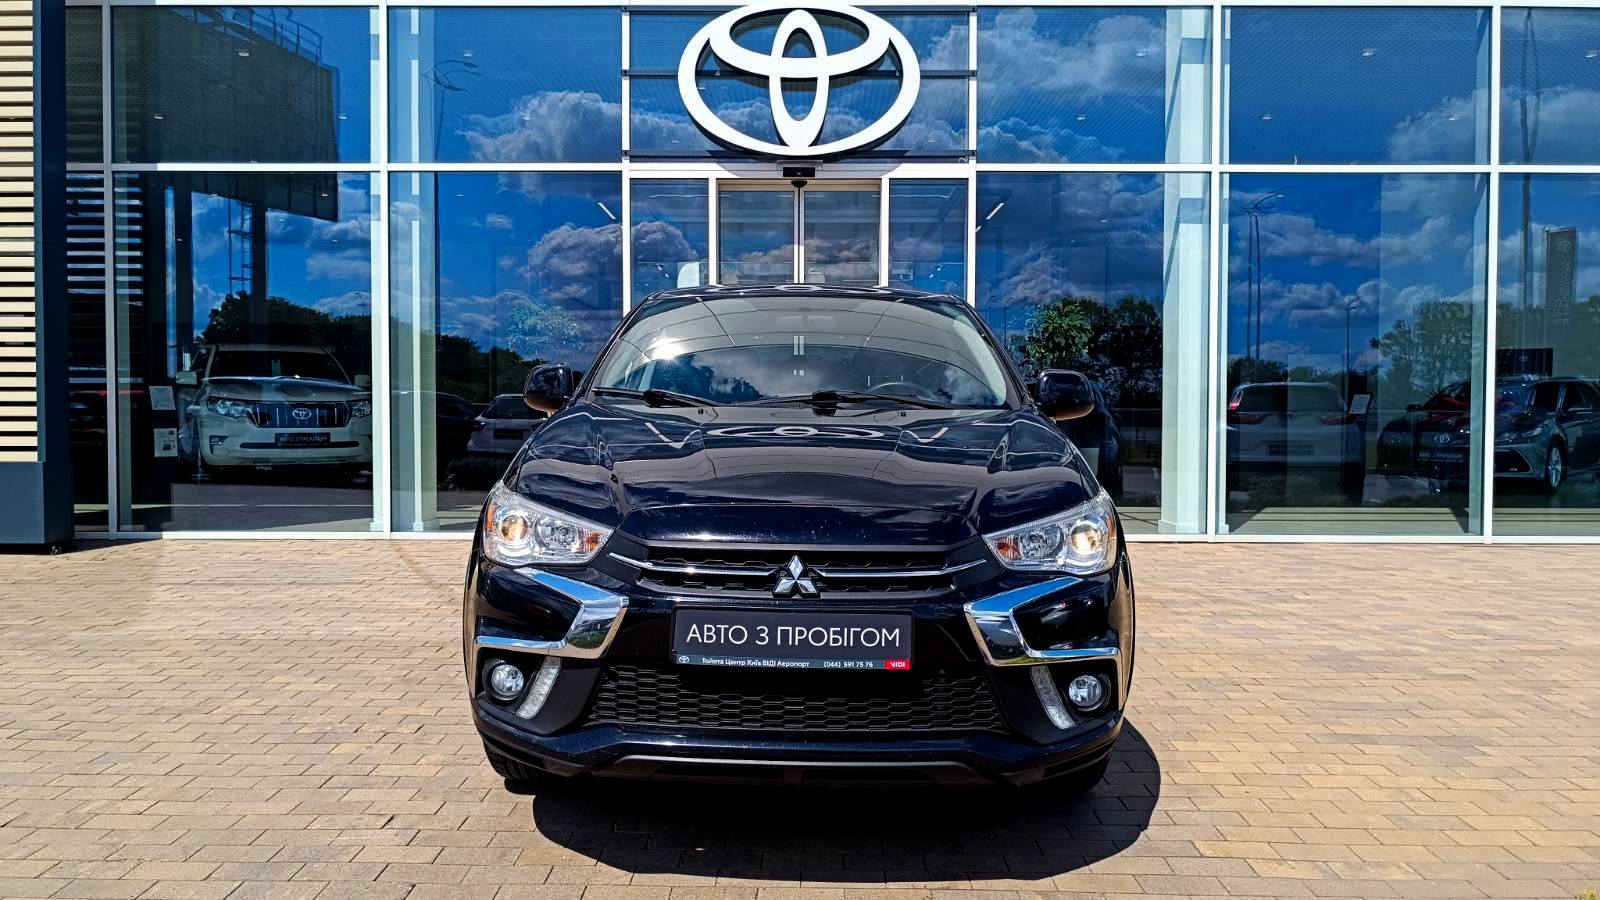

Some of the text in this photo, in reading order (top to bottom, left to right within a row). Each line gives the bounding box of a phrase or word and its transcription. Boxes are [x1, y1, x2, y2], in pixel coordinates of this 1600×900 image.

[686, 623, 900, 647] АВТО З ПРОБІГОМ
[702, 658, 724, 666] Тойота
[725, 659, 745, 667] Центр
[777, 660, 810, 669] Аеропорт
[823, 660, 841, 669] (044)
[843, 660, 855, 668] 591
[855, 660, 864, 668] 75
[864, 660, 873, 668] 76
